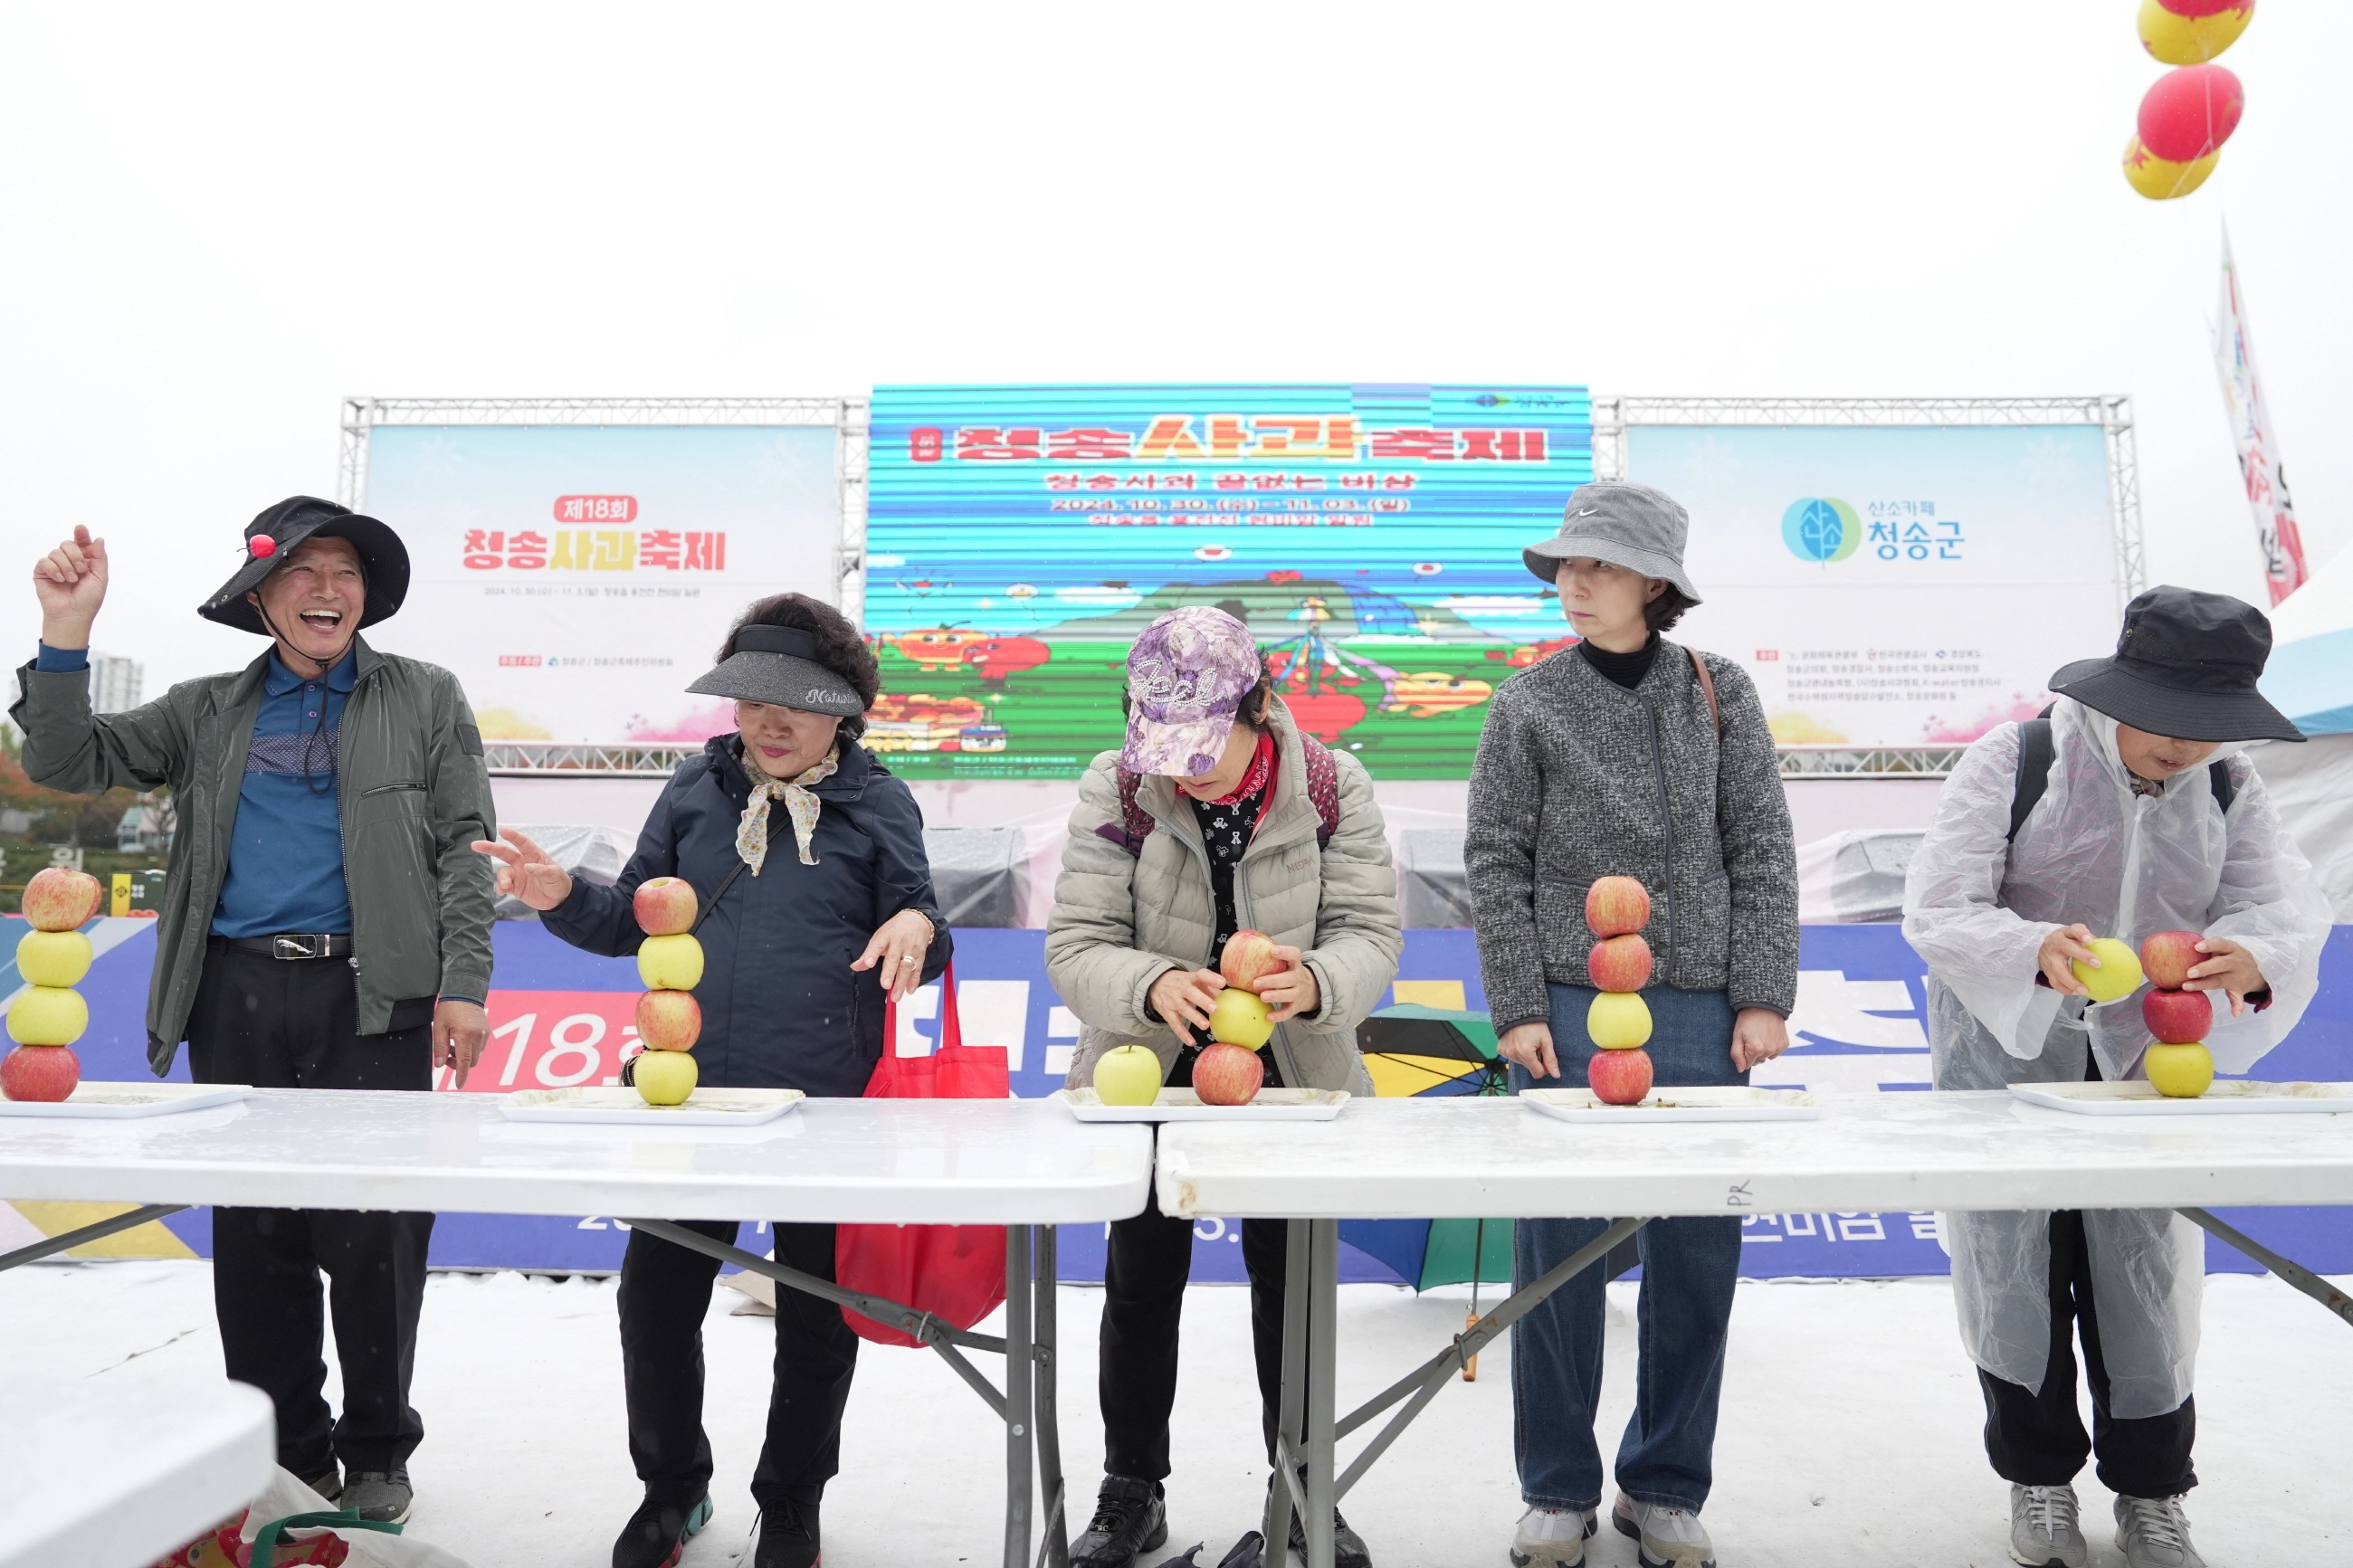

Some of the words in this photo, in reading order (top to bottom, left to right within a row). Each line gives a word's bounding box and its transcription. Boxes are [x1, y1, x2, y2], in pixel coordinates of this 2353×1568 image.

[955, 414, 1548, 463] 청송사과축제
[1341, 473, 1414, 489] 비상
[563, 499, 628, 519] 제18회
[1868, 500, 1935, 517] 산소카페
[463, 529, 726, 570] 청송사과축제
[1868, 522, 1965, 560] 청송군
[1727, 1179, 1753, 1206] PR
